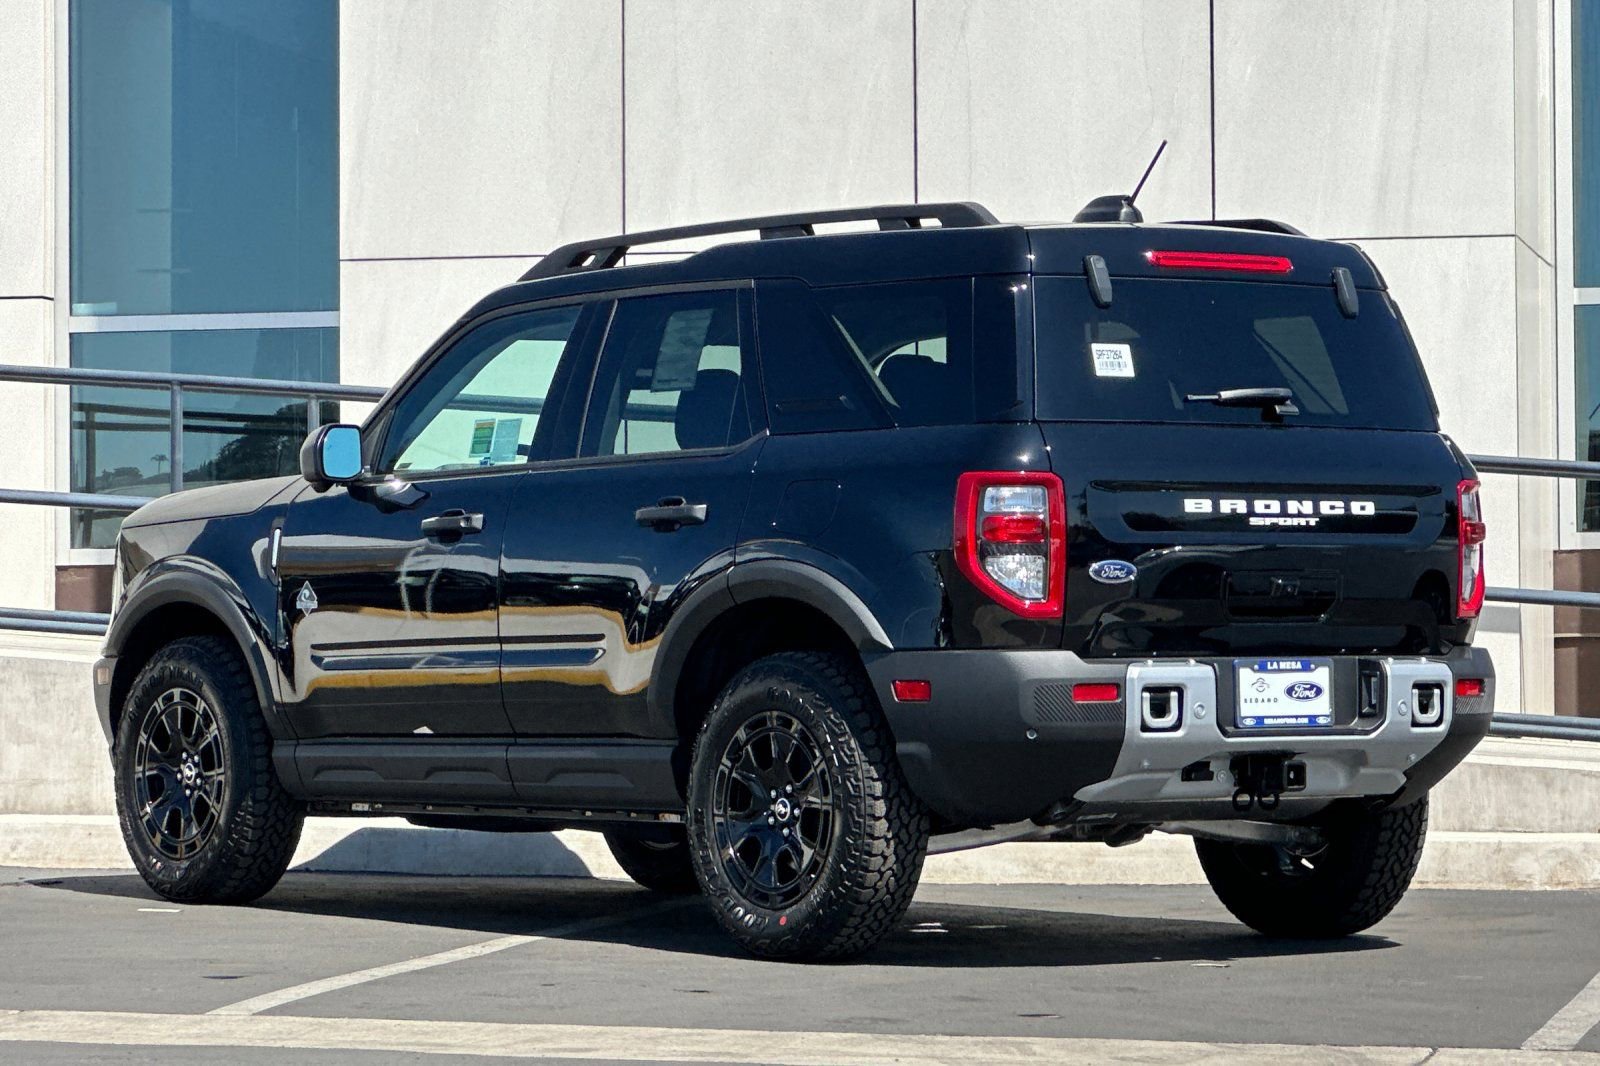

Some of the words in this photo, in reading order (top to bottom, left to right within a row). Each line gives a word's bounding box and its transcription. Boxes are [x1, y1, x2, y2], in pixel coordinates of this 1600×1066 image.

[1183, 498, 1376, 515] BRONCO
[1248, 517, 1320, 526] SPORT
[1100, 564, 1127, 578] Ford
[1267, 661, 1278, 670] LA
[1279, 661, 1302, 670] MESA
[1292, 683, 1317, 699] Ford
